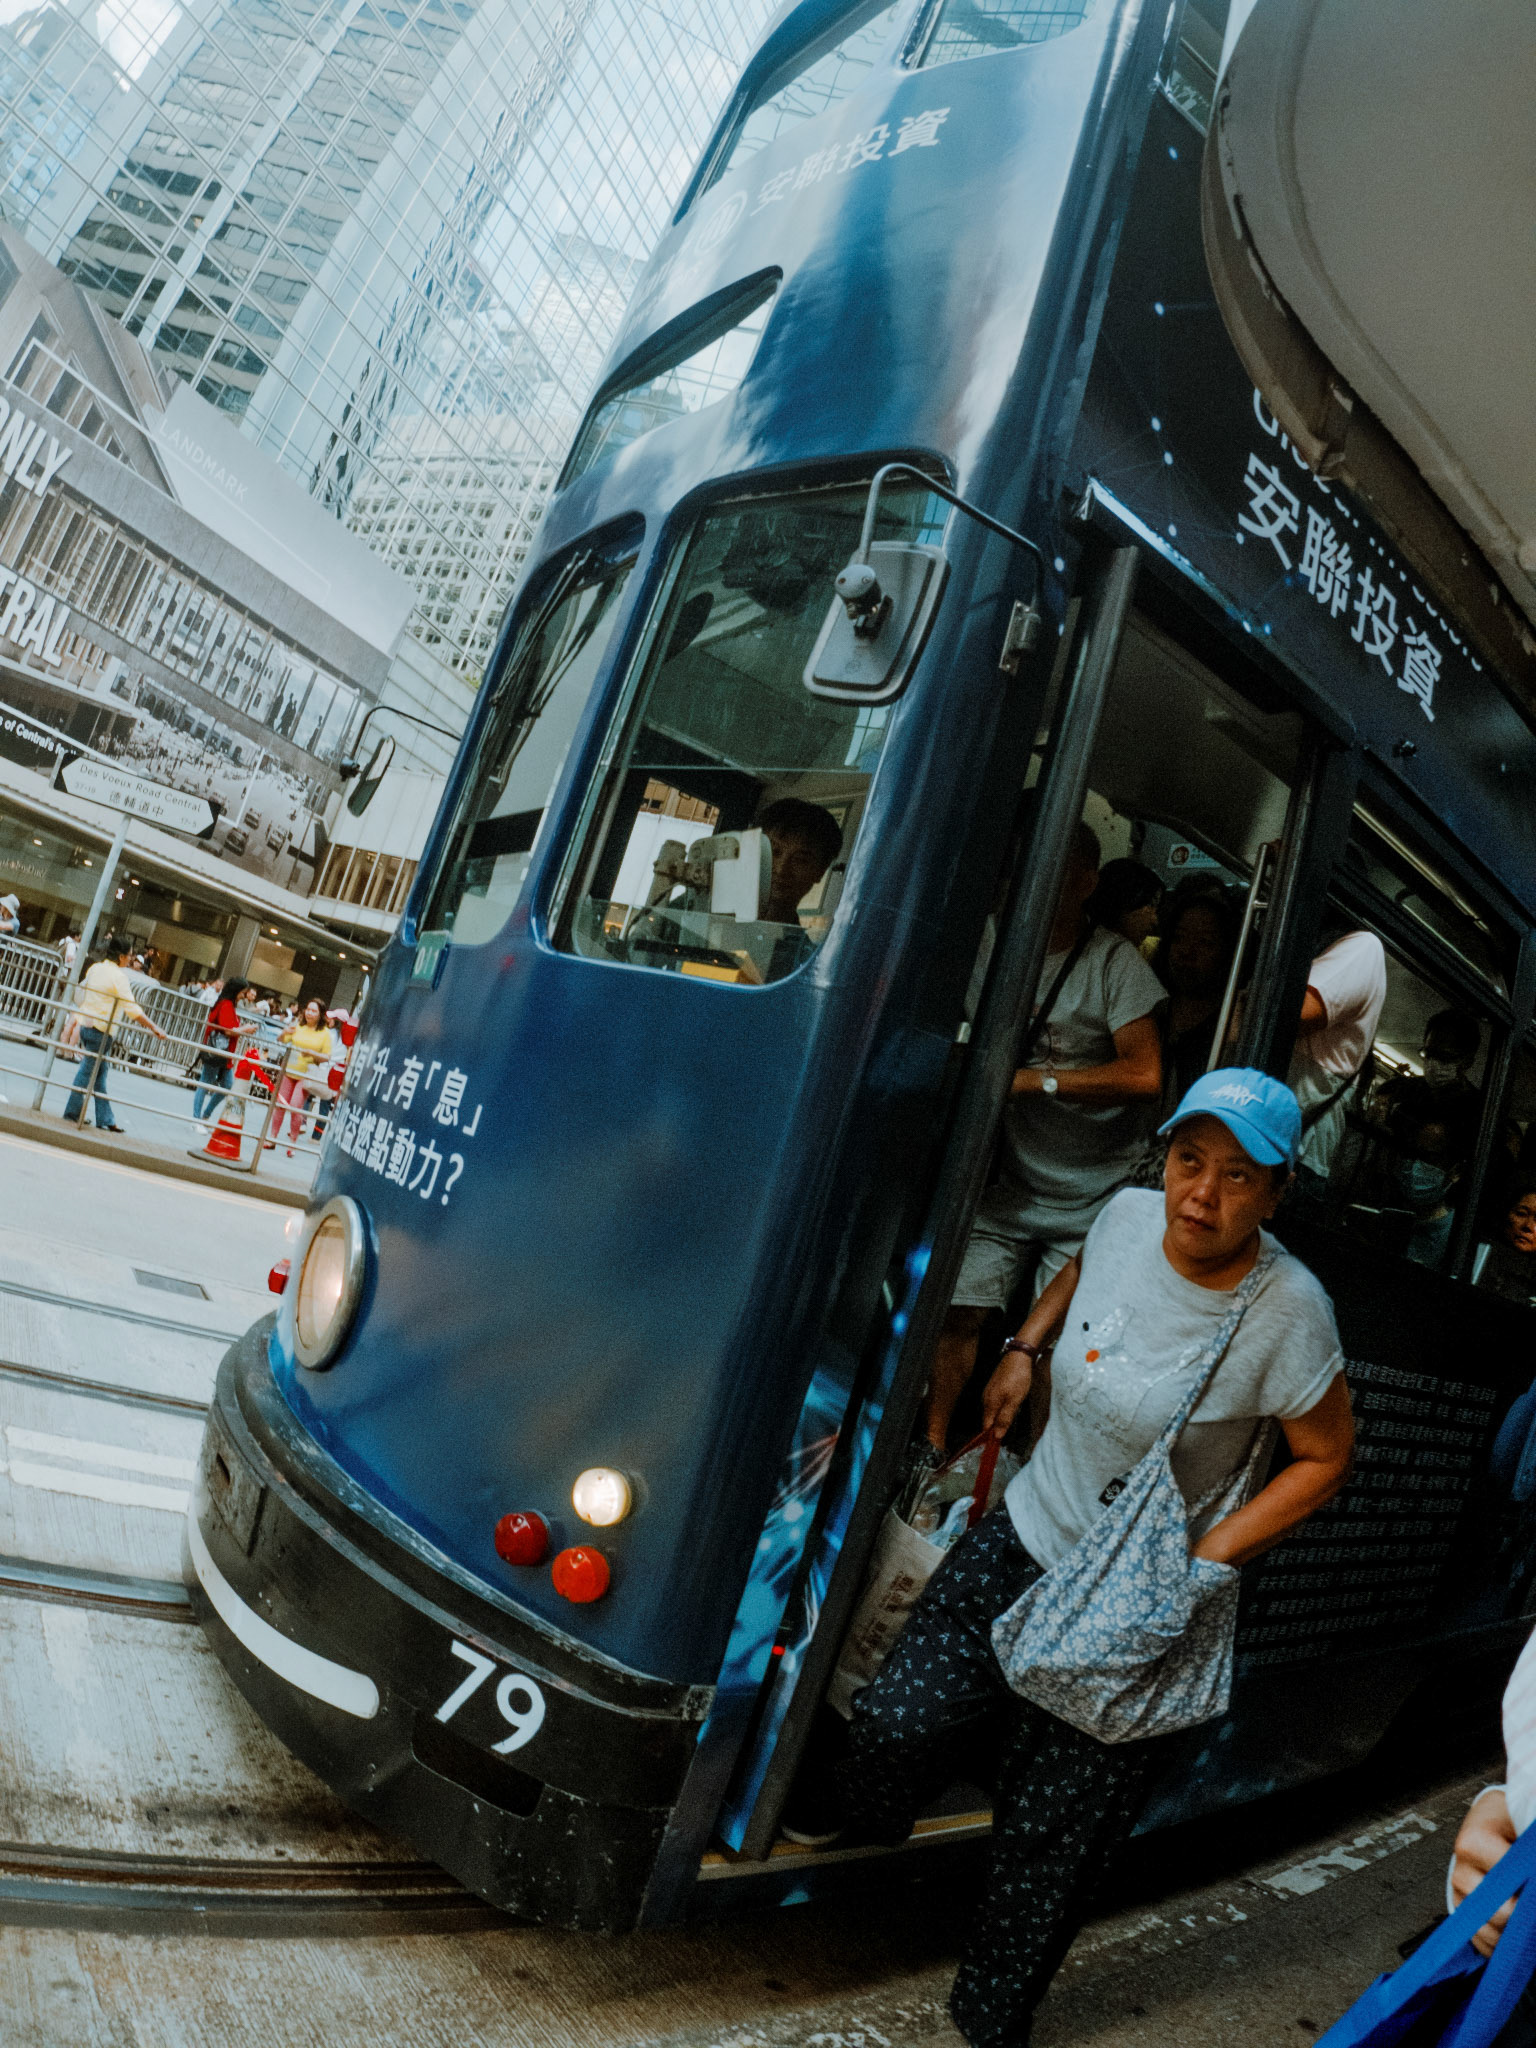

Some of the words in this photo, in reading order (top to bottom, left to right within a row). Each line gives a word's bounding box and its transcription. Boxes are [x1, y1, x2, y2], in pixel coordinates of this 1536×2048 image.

[750, 106, 951, 216] 安聯投資
[159, 418, 249, 504] LANDMARK
[1238, 452, 1443, 723] 安聯投資
[5, 720, 17, 732] of
[16, 723, 54, 752] Central's
[79, 763, 98, 777] Des
[102, 771, 132, 788] Voeux
[135, 783, 162, 799] Road
[164, 793, 202, 813] Central
[109, 791, 164, 817] 德輔道中
[345, 1040, 483, 1137] 有「升」有「息」
[433, 1638, 547, 1756] 79
